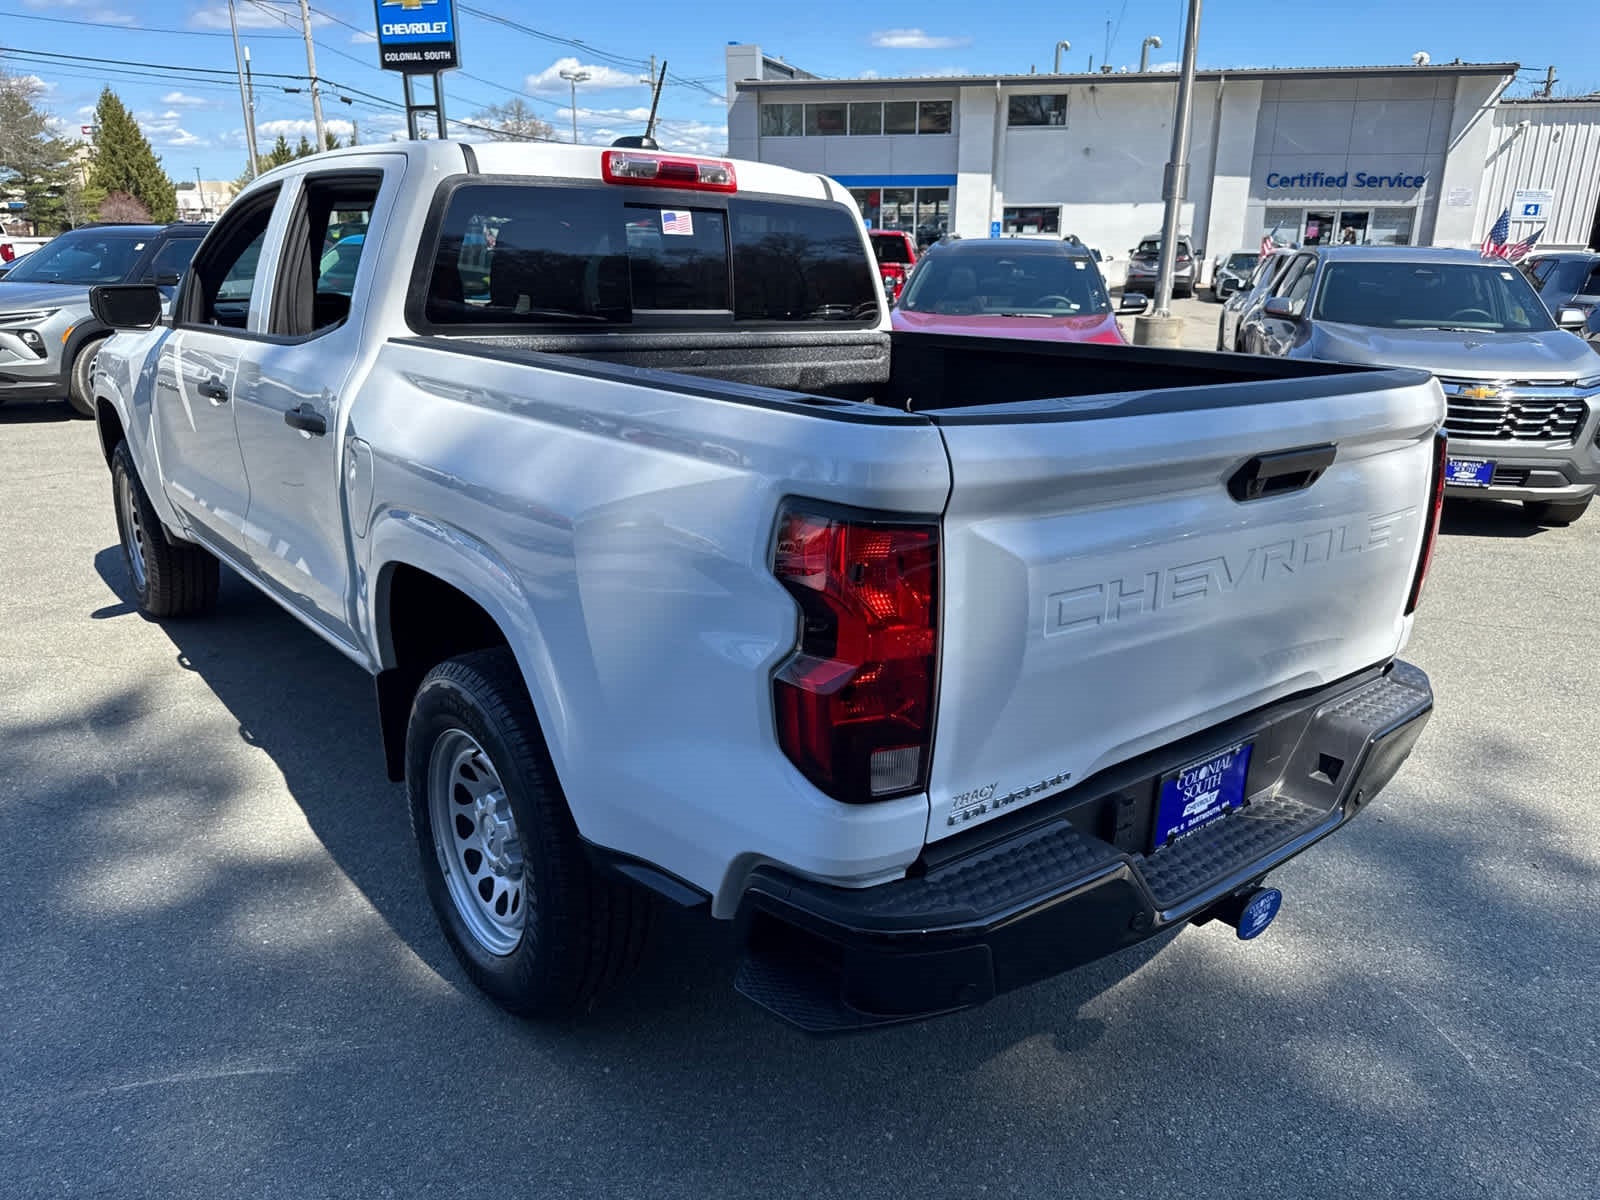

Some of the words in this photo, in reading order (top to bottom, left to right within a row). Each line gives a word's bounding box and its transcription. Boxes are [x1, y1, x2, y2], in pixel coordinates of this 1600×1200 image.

[382, 22, 448, 35] CHEVROLET
[384, 52, 422, 62] COLONIAL
[424, 51, 451, 60] SOUTH
[1266, 172, 1349, 189] Certified
[1354, 172, 1426, 189] Service
[1527, 205, 1537, 215] 4
[1043, 506, 1417, 639] CHEVROLET
[1176, 756, 1232, 791] COLONIAL
[952, 781, 998, 809] TRACY
[1183, 772, 1222, 801] SOUTH
